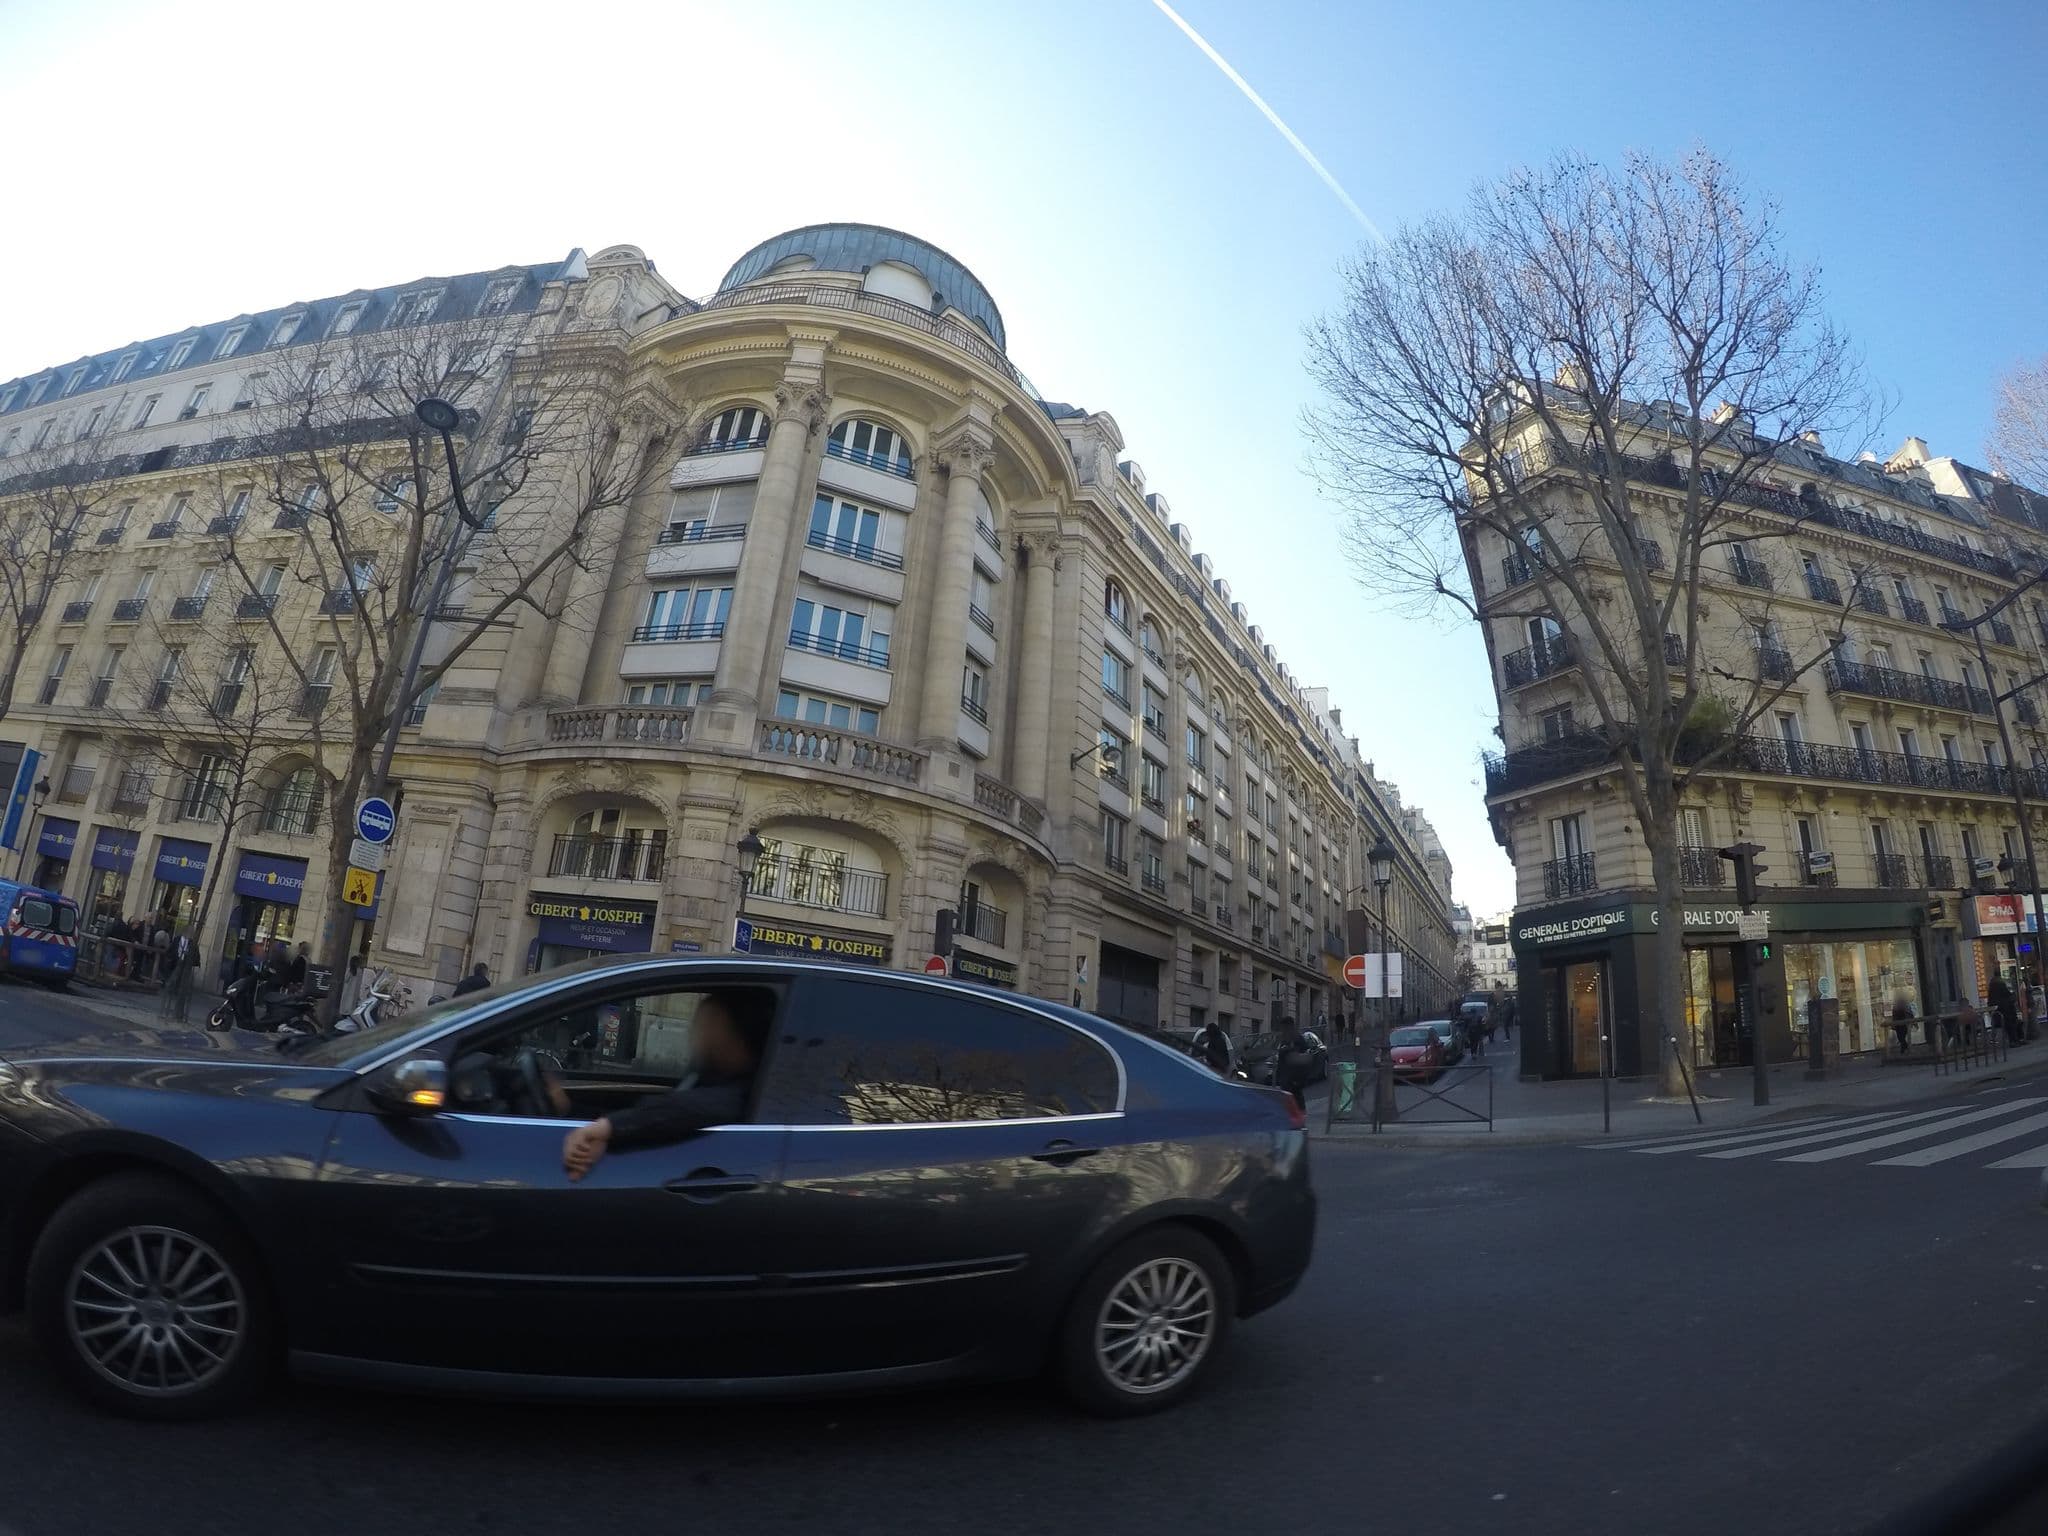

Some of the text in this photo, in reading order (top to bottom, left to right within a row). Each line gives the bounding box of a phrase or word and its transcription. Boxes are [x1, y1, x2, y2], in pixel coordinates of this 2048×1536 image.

[239, 869, 267, 882] GIBERT
[530, 902, 643, 924] GIBERT JOSEPH
[1519, 921, 1569, 940] GENERALE
[1571, 911, 1625, 931] D'OPTIQUE
[751, 926, 884, 959] GIBERT JOSEPH
